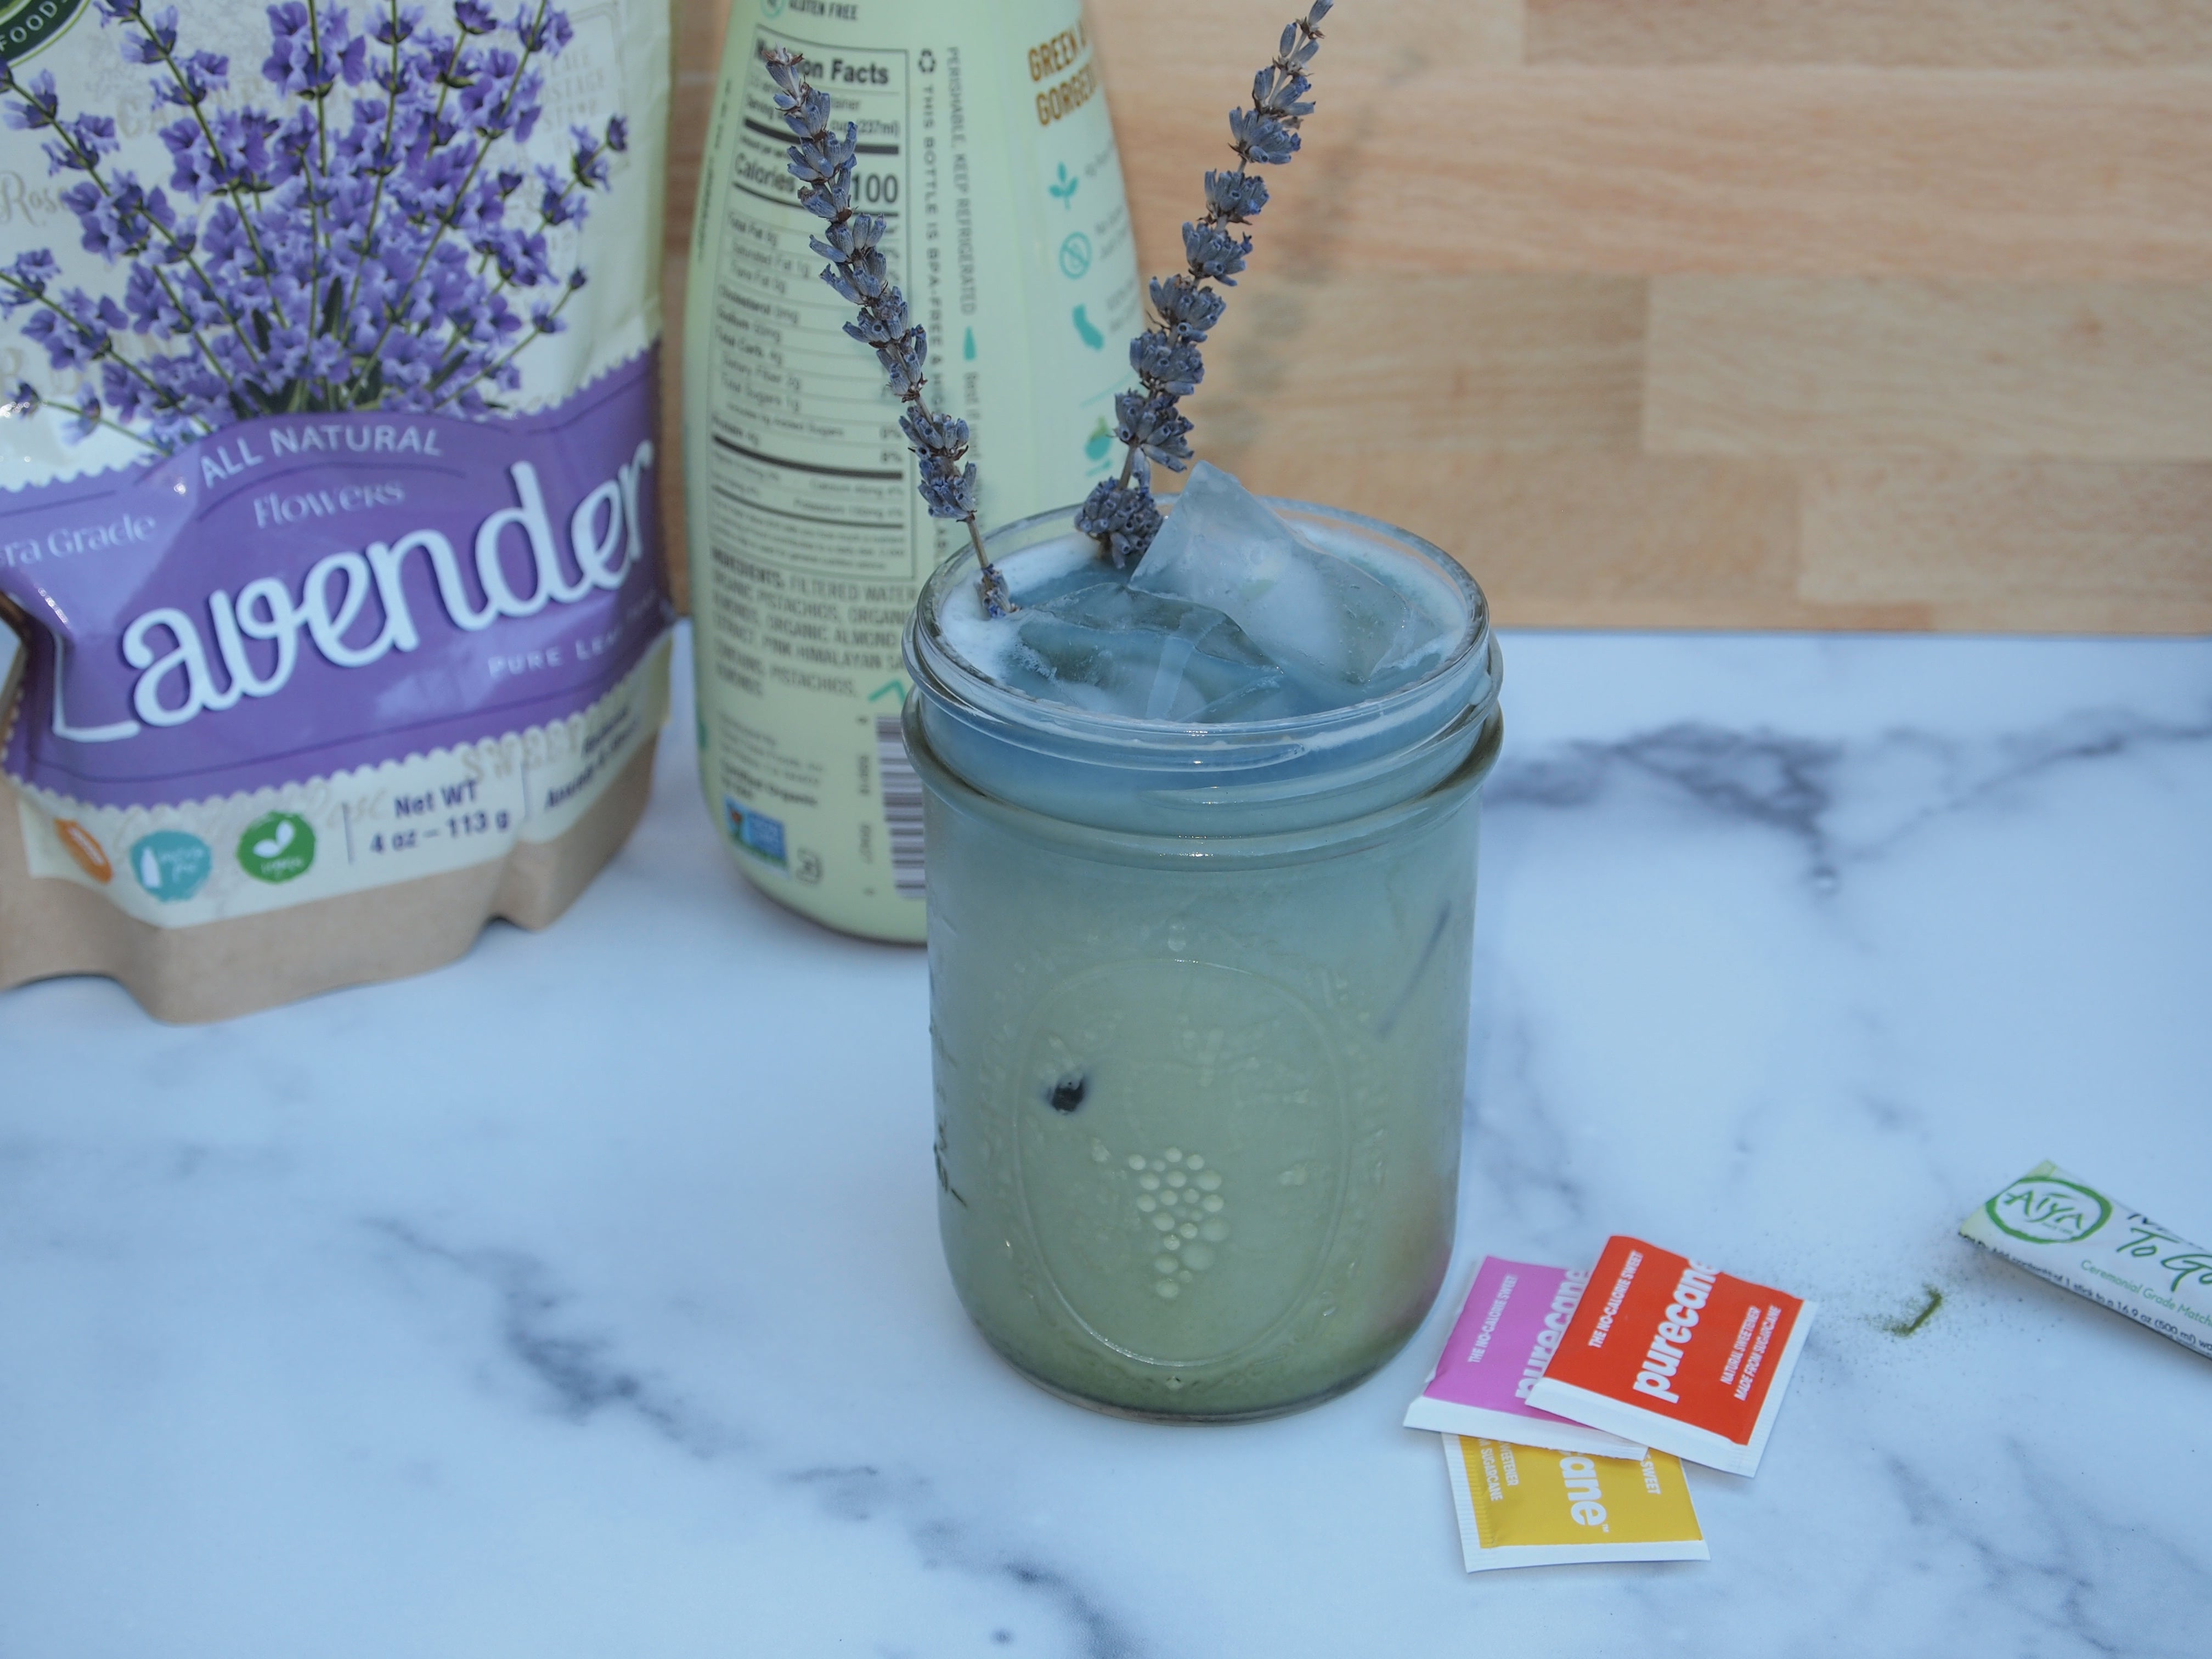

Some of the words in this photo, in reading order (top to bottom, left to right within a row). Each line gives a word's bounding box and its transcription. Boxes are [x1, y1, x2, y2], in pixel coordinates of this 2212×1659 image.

[828, 3, 857, 20] FREE
[831, 57, 889, 86] Facts
[1029, 27, 1077, 81] GREEN
[923, 86, 935, 129] THIS
[735, 153, 795, 191] Calories
[851, 173, 898, 204] 100
[923, 137, 939, 215] BOTTLE
[926, 222, 939, 241] IS
[955, 198, 978, 317] REFRIGERATED
[926, 247, 943, 346] BPA-FREE
[201, 437, 264, 489] ALL
[269, 425, 443, 456] NATURAL
[47, 513, 156, 558] Grade
[52, 441, 654, 743] Lavender
[789, 575, 859, 601] FILTERED
[488, 645, 562, 678] PURE
[394, 791, 434, 819] Net
[441, 779, 476, 807] WT
[370, 833, 384, 853] 4
[391, 830, 415, 850] oz
[446, 811, 487, 839] 113
[495, 810, 510, 832] g
[2115, 1227, 2180, 1257] To
[1621, 1249, 1644, 1280] SWEET
[2081, 1259, 2143, 1294] Ceremonial
[2143, 1288, 2176, 1311] Grade
[1497, 1274, 1518, 1300] SWEET
[1596, 1277, 1631, 1332] NO-CALORIE
[1475, 1299, 1508, 1348] NO-CALORIE
[1588, 1330, 1607, 1348] THE
[1633, 1260, 1721, 1404] purecane
[1720, 1350, 1744, 1385] NATURAL
[1734, 1305, 1762, 1352] SWEETENER
[1753, 1304, 1782, 1354] SUGARCANE
[1468, 1347, 1486, 1363] THE
[1743, 1351, 1763, 1378] FROM
[1734, 1373, 1753, 1401] MADE
[1480, 1447, 1504, 1502] SUGARCANE
[1498, 1441, 1520, 1487] WEETENER
[1639, 1460, 1662, 1495] SWEET
